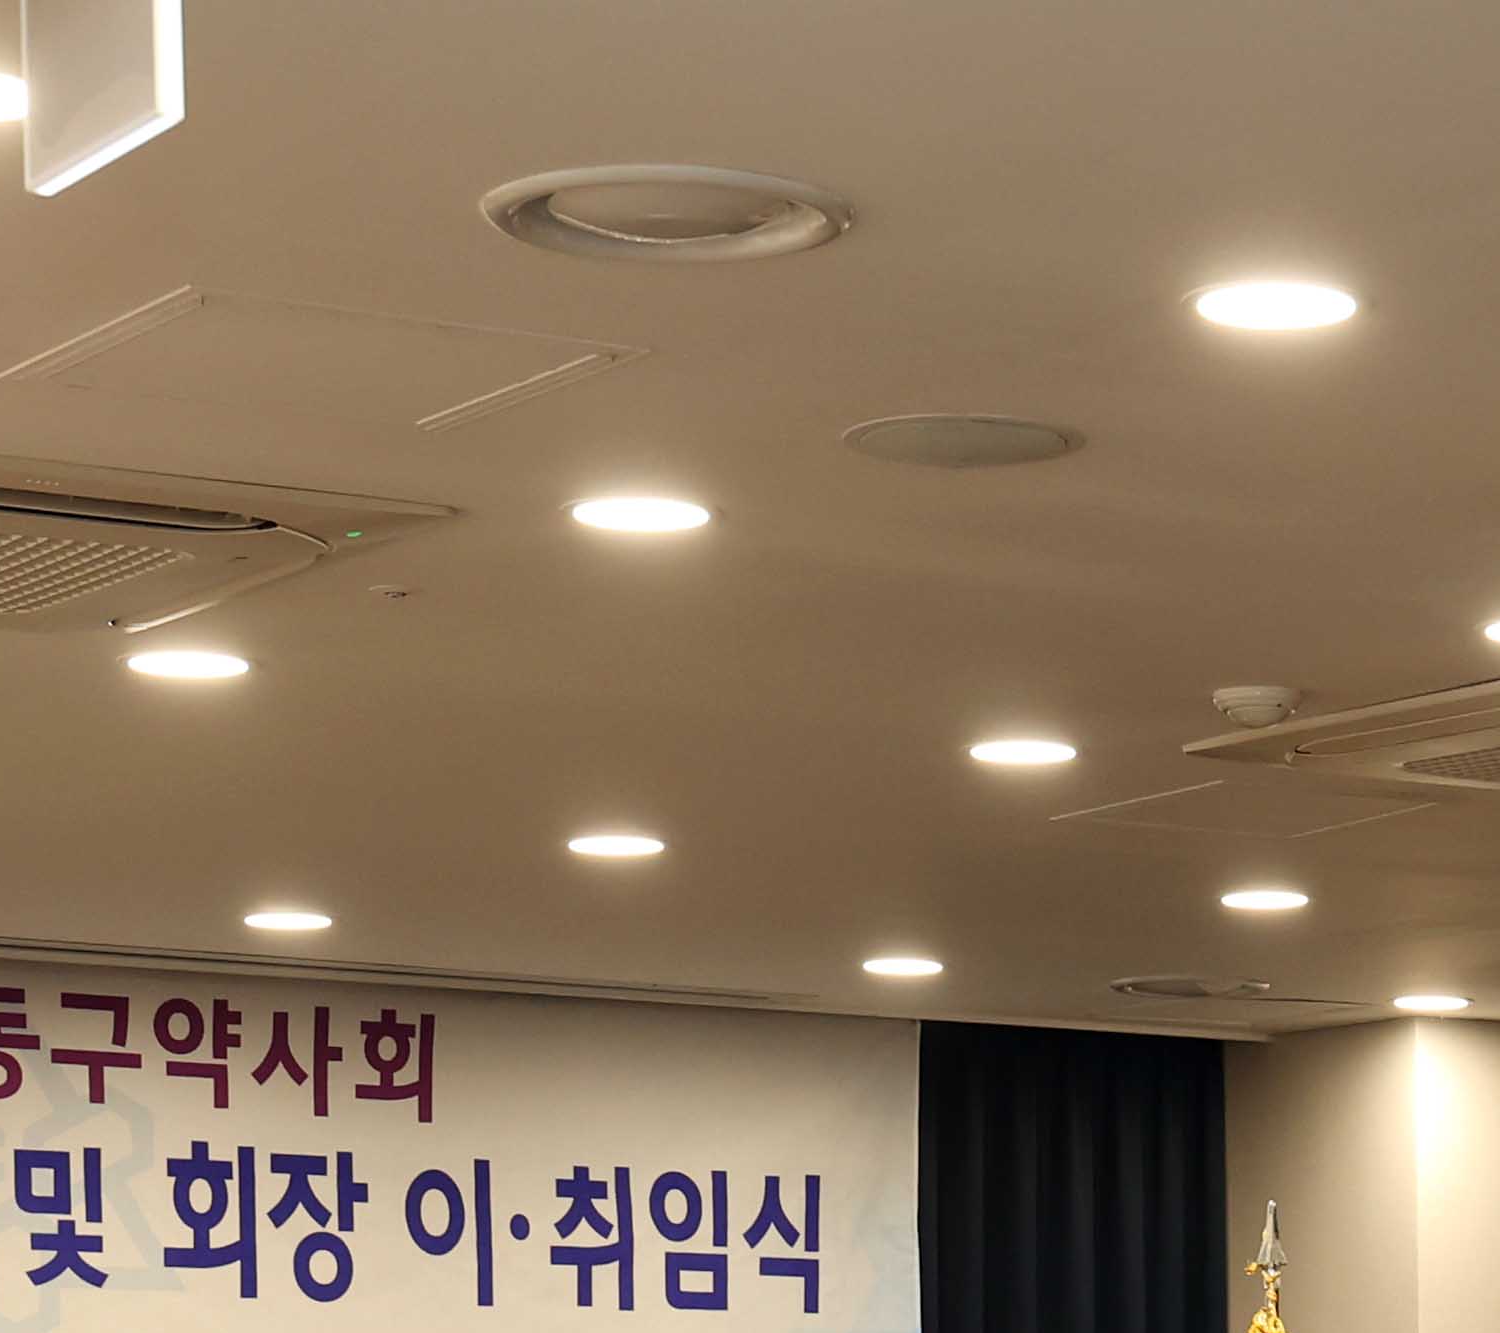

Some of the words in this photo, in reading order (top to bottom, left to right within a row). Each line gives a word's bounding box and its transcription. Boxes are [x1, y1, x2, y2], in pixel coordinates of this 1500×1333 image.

[13, 1147, 110, 1290] 및
[164, 1140, 370, 1304] 회장
[404, 1157, 823, 1315] 이·취임식
